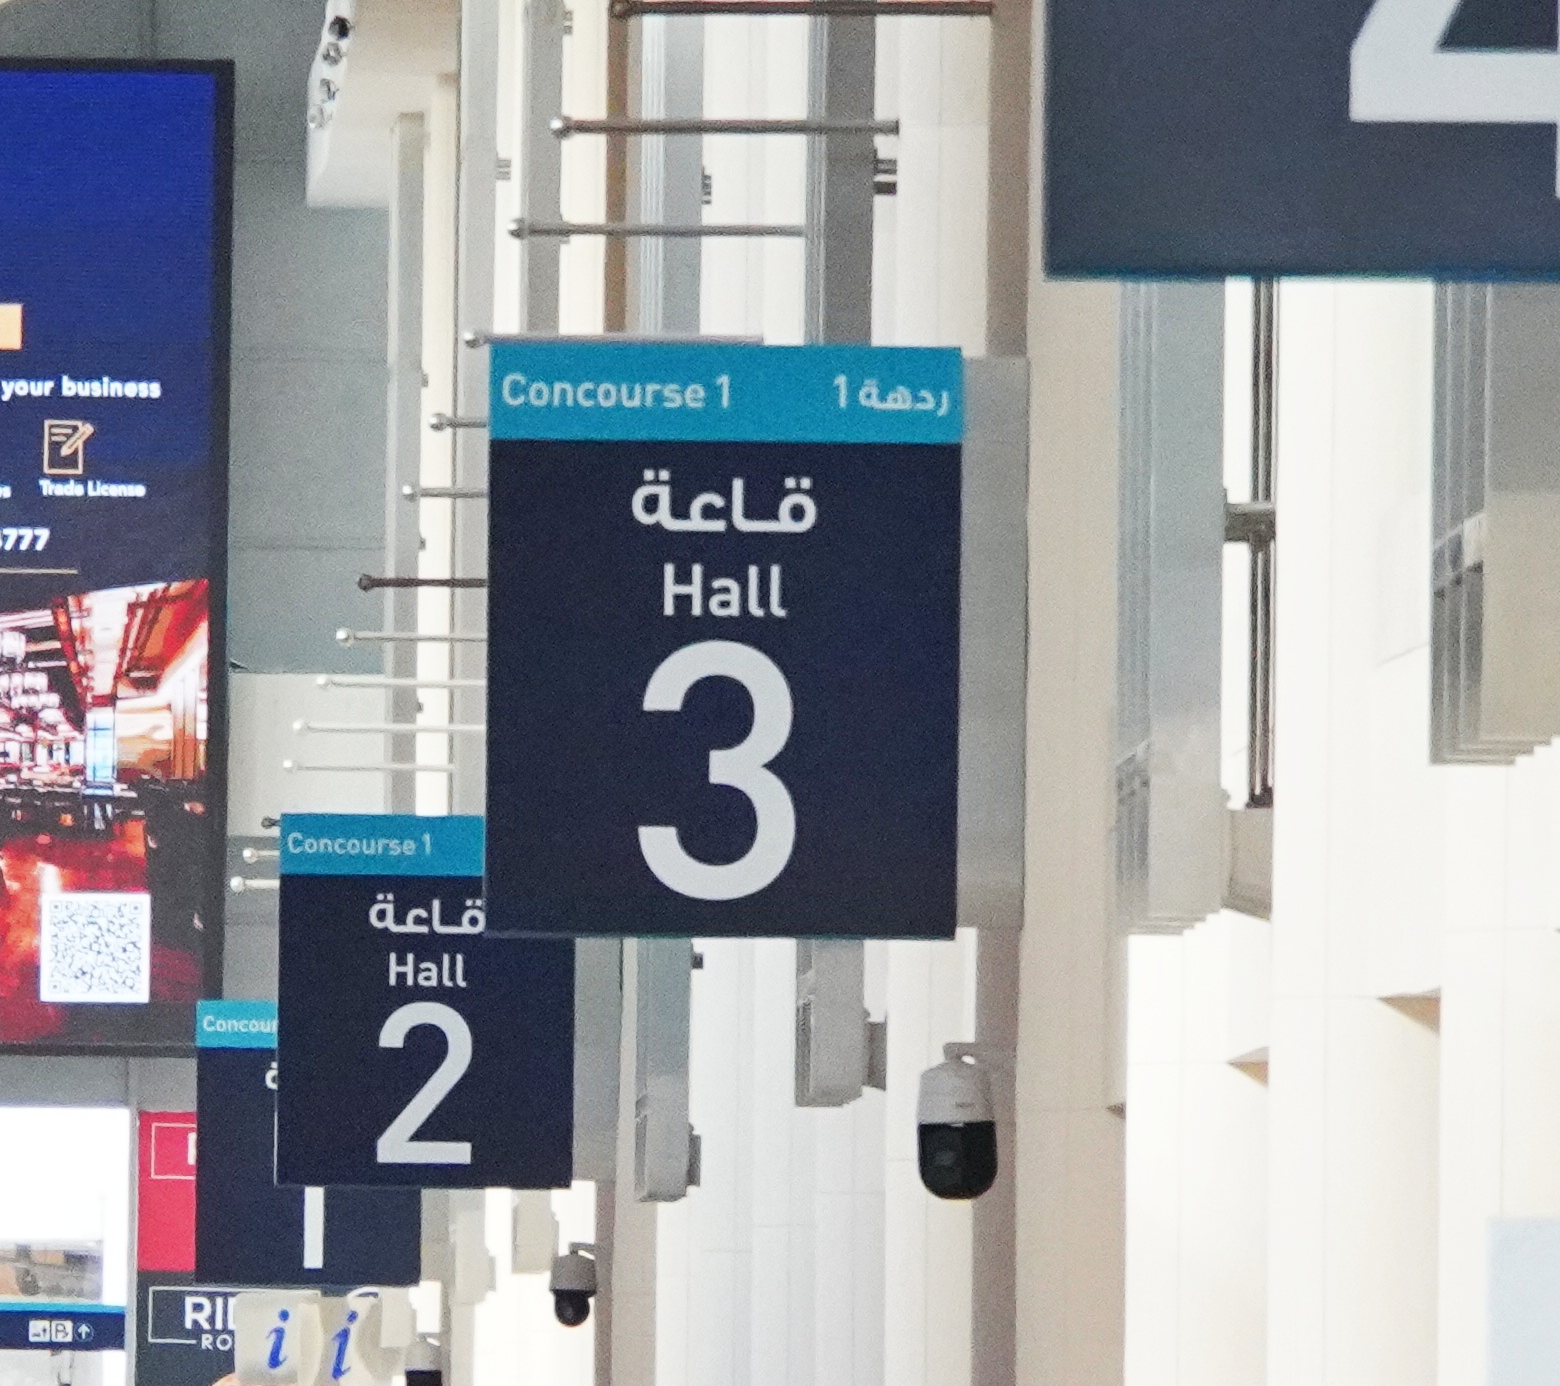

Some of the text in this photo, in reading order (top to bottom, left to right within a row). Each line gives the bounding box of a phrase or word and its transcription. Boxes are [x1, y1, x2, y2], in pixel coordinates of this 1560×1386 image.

[1, 379, 54, 400] your
[62, 376, 162, 400] business
[501, 372, 733, 410] Concourse 1
[832, 374, 950, 416] ردهة 1
[39, 478, 147, 499] Trade License
[631, 468, 818, 534] قاعة
[663, 563, 789, 618] Hall
[637, 639, 796, 902] 3
[287, 832, 433, 857] Concourse 1
[368, 893, 487, 936] قاعة
[388, 952, 468, 988] Hall
[376, 1001, 473, 1166] 2
